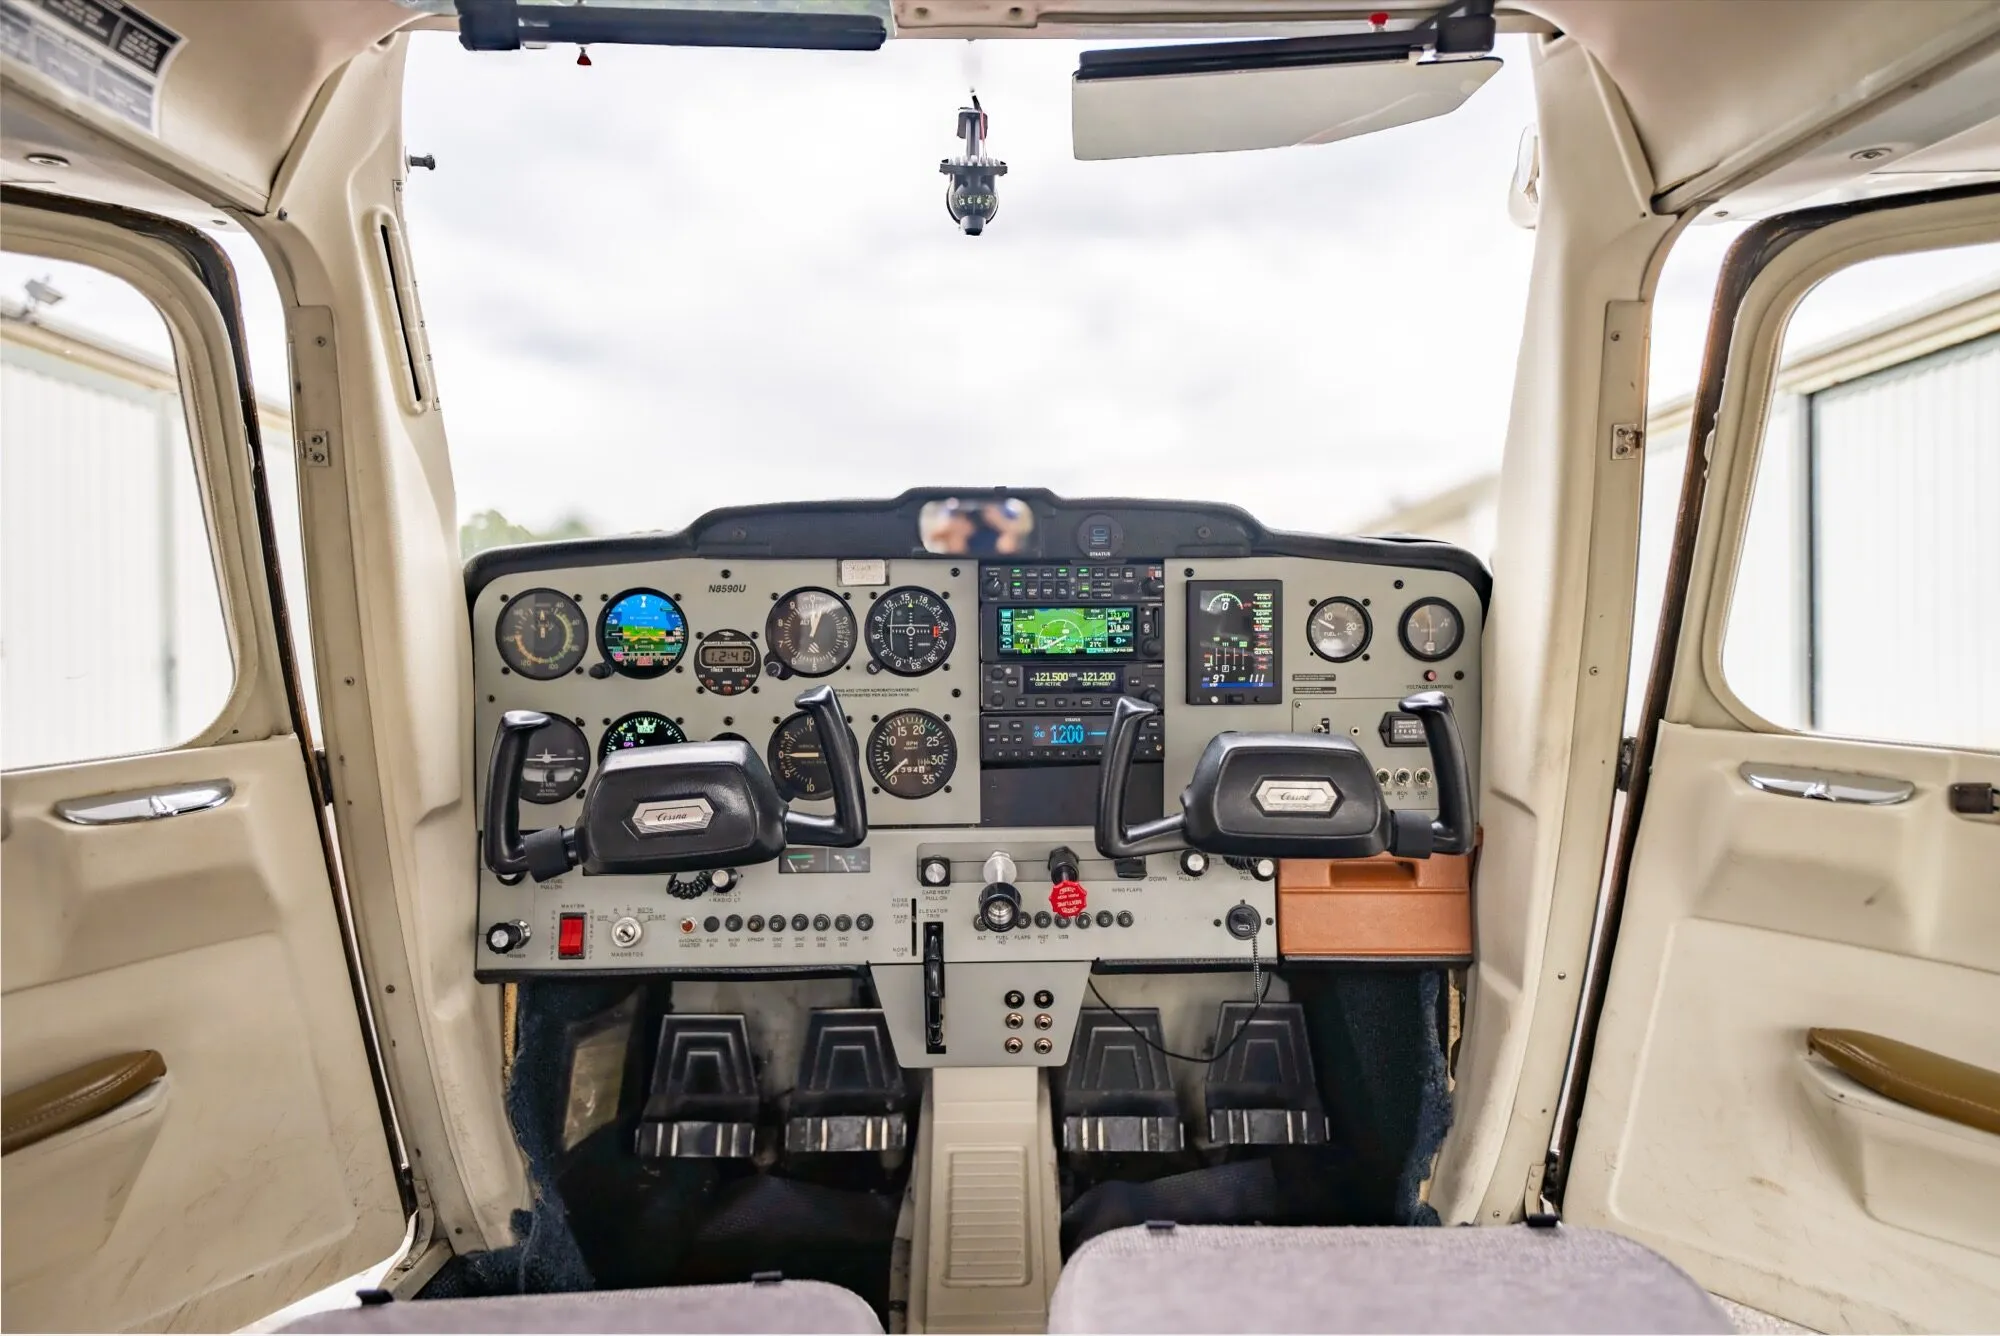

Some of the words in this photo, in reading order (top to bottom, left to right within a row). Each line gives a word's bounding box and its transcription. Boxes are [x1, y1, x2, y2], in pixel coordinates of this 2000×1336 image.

[708, 584, 746, 593] N8590U
[920, 595, 928, 603] 18
[884, 600, 894, 609] 12
[1222, 602, 1229, 611] 0
[933, 606, 943, 614] 21
[1324, 612, 1333, 620] 10
[778, 619, 783, 627] 8
[941, 621, 949, 632] 24
[1346, 622, 1357, 631] 20
[939, 640, 947, 650] 27
[928, 654, 938, 663] 30
[911, 662, 921, 670] 33
[1035, 672, 1069, 682] 121.500
[1082, 672, 1116, 681] 121.200
[1212, 674, 1225, 682] 97
[1250, 674, 1265, 682] 111
[806, 717, 815, 726] 10
[898, 726, 907, 736] 15
[913, 725, 925, 735] 20
[1050, 724, 1084, 744] 1200
[887, 736, 897, 746] 10
[926, 736, 939, 747] 25
[778, 751, 784, 759] 0
[883, 752, 890, 761] 5
[931, 755, 943, 765] 30
[785, 770, 790, 778] 5
[890, 776, 897, 785] 0
[922, 774, 936, 784] 35
[806, 784, 815, 792] 10
[1281, 792, 1310, 801] Cessna
[656, 812, 687, 822] Cessna
